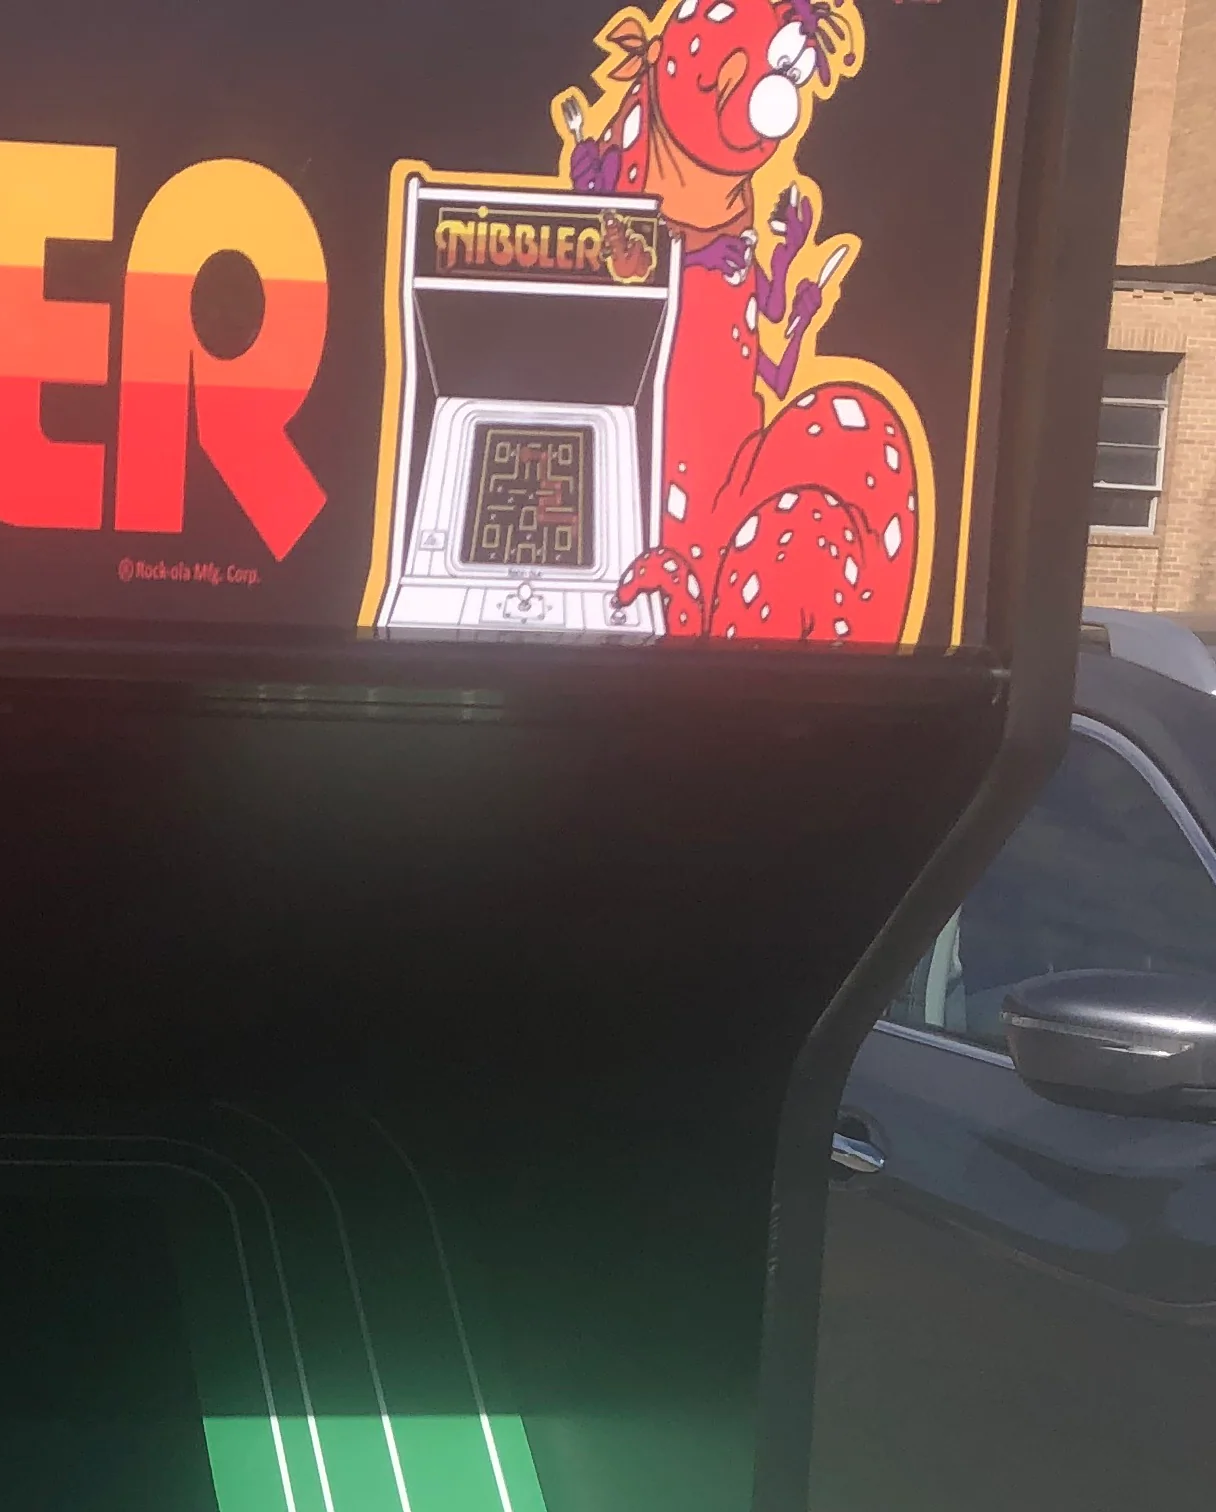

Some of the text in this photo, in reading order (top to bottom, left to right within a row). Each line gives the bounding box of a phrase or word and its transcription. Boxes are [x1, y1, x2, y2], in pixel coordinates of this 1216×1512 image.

[435, 206, 602, 272] NIBBLER
[194, 562, 222, 586] Mfg.
[226, 564, 261, 586] Corp.
